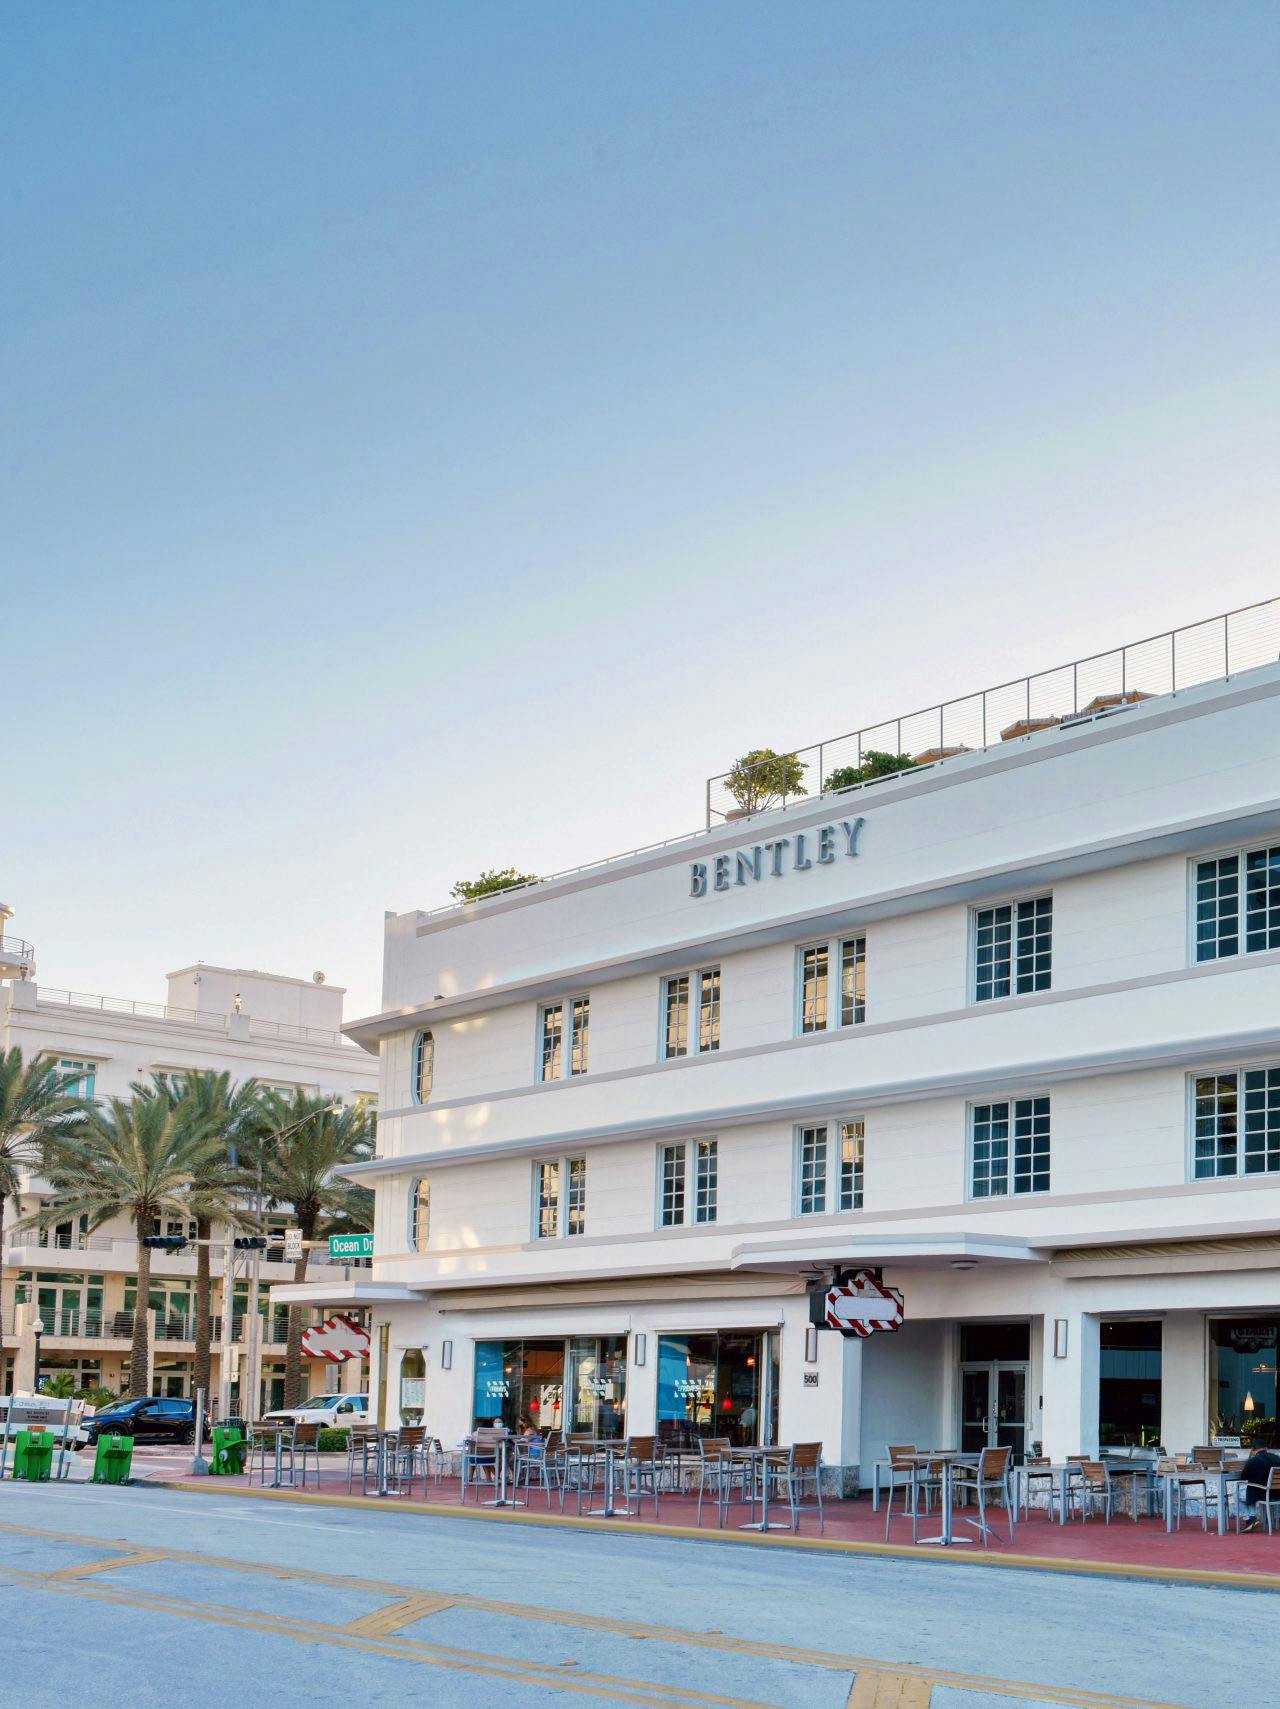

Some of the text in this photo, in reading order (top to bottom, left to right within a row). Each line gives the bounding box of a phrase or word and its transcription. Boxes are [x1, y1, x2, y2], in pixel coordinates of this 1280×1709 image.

[688, 817, 866, 898] BENTLEY
[333, 1237, 373, 1252] Ocean Dr
[804, 1374, 817, 1384] 500
